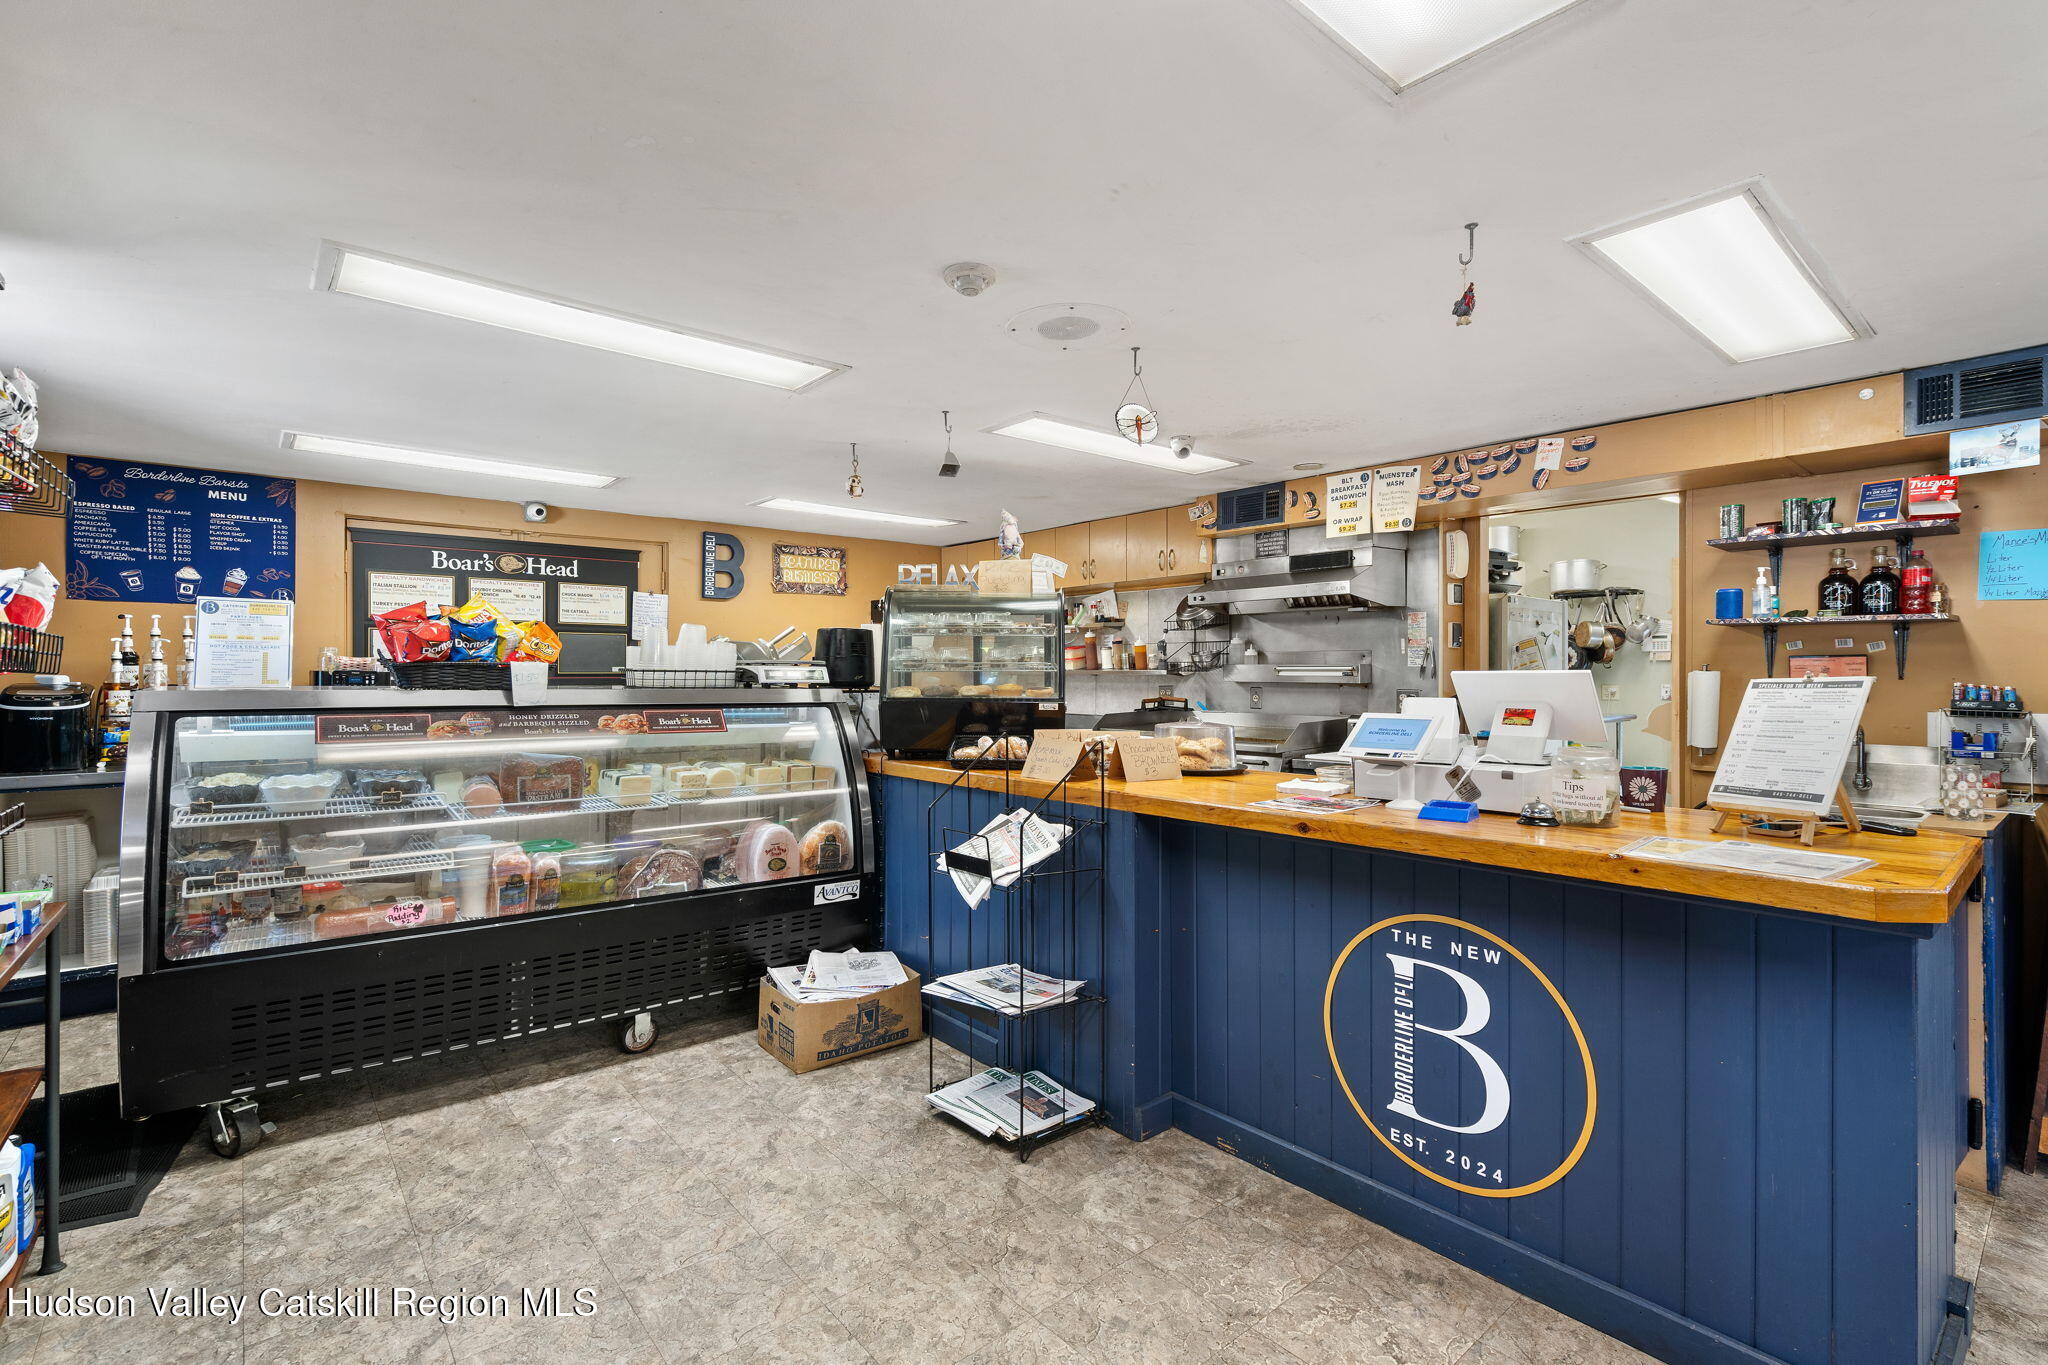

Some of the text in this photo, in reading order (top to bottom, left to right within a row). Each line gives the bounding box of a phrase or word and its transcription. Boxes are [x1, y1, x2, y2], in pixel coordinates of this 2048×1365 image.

[124, 467, 249, 489] Borderline Barista
[1910, 479, 1956, 489] TYLENOL
[1331, 483, 1367, 494] BREAKFAST
[208, 490, 247, 502] MENU
[1331, 492, 1366, 501] SANDWICH
[74, 501, 110, 509] ESPRESSO
[432, 550, 579, 578] Boar's Head
[1987, 553, 2012, 563] Liter
[705, 535, 716, 596] BORDERLINE DELI
[1998, 564, 2024, 572] Liter
[783, 569, 838, 583] BUSINESS
[455, 639, 490, 648] Doritos
[339, 723, 413, 733] Boar's Head
[1563, 781, 1584, 793] Tips
[393, 903, 412, 912] Rice
[386, 912, 420, 922] Pudding
[1392, 928, 1501, 965] THE NEW
[1394, 974, 1414, 1104] BORDERLINE DELI
[818, 1031, 908, 1060] IDAHO POTATOES
[1031, 1075, 1055, 1094] TIMES
[1390, 1128, 1502, 1183] EST. 2024
